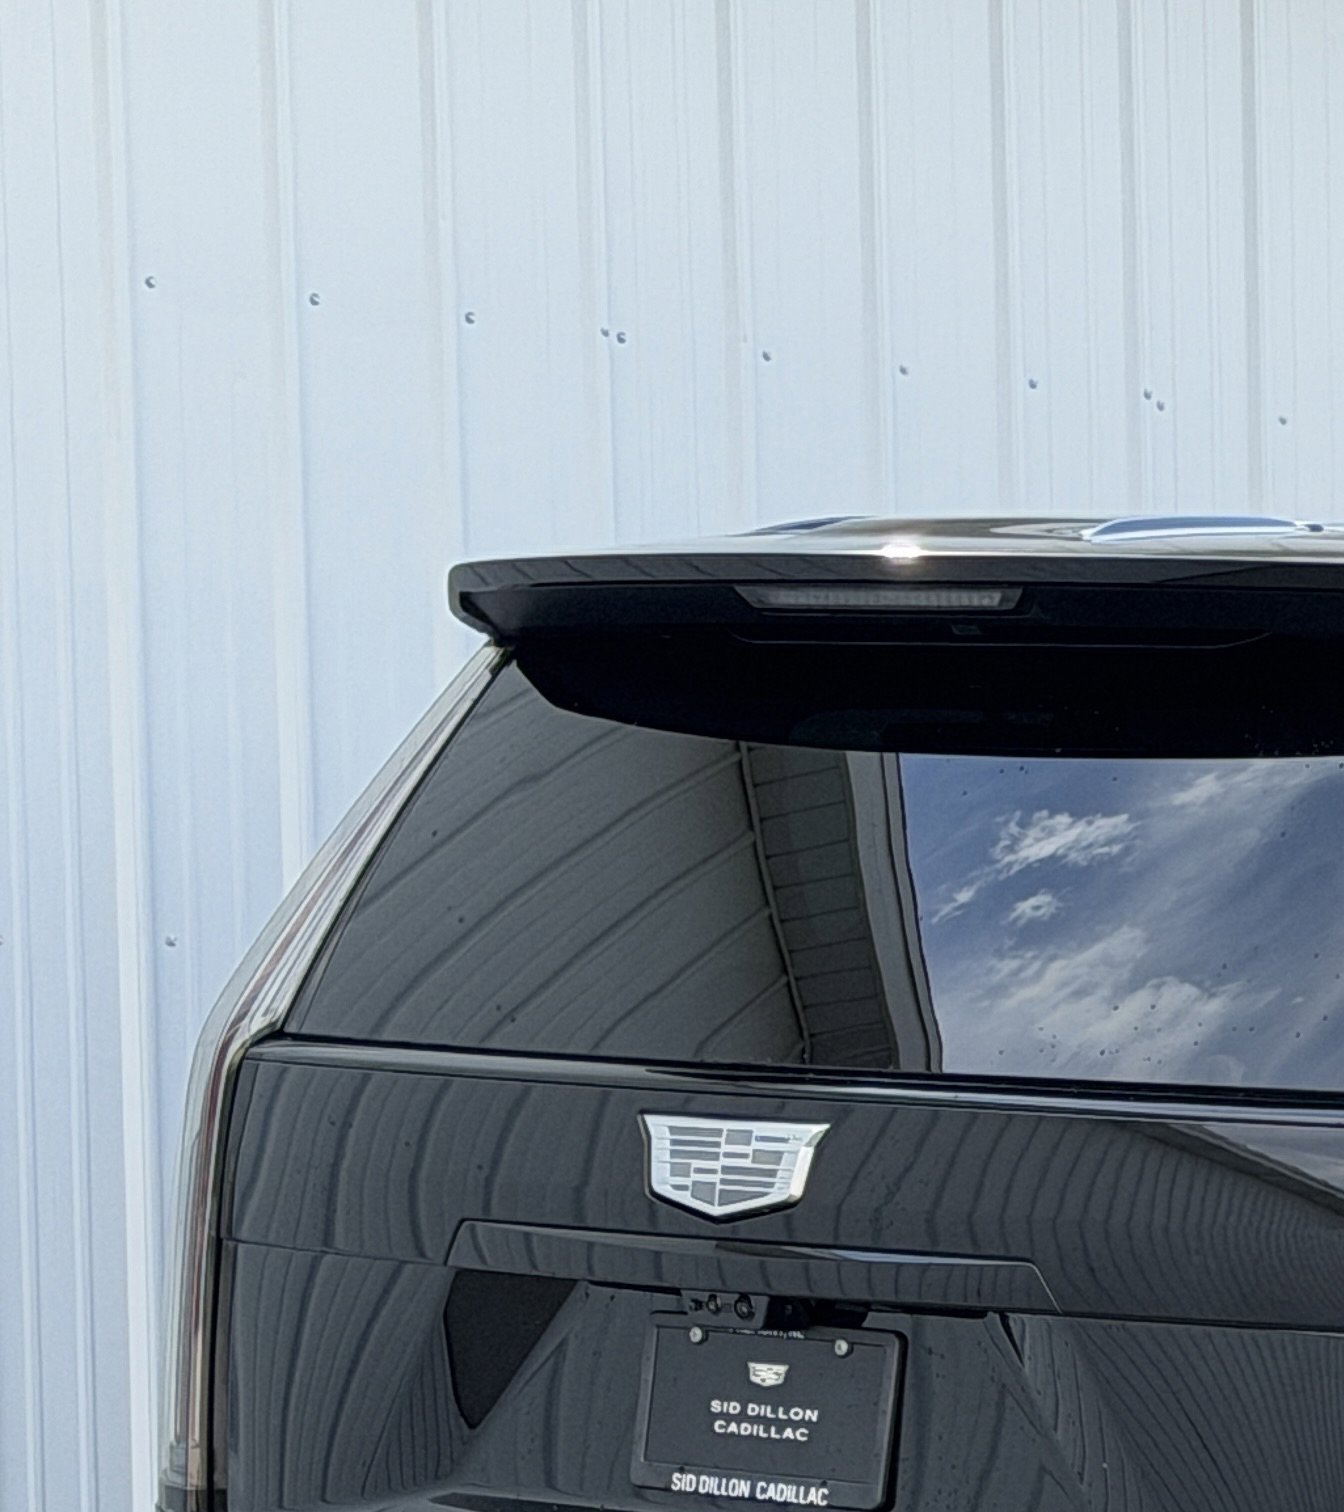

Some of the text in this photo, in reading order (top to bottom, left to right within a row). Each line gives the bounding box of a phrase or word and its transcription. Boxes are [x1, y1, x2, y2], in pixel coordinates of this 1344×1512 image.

[710, 1400, 819, 1423] SID DILLON
[713, 1420, 809, 1442] CADILLAC
[671, 1472, 829, 1507] SID DILLON CADILLAC
